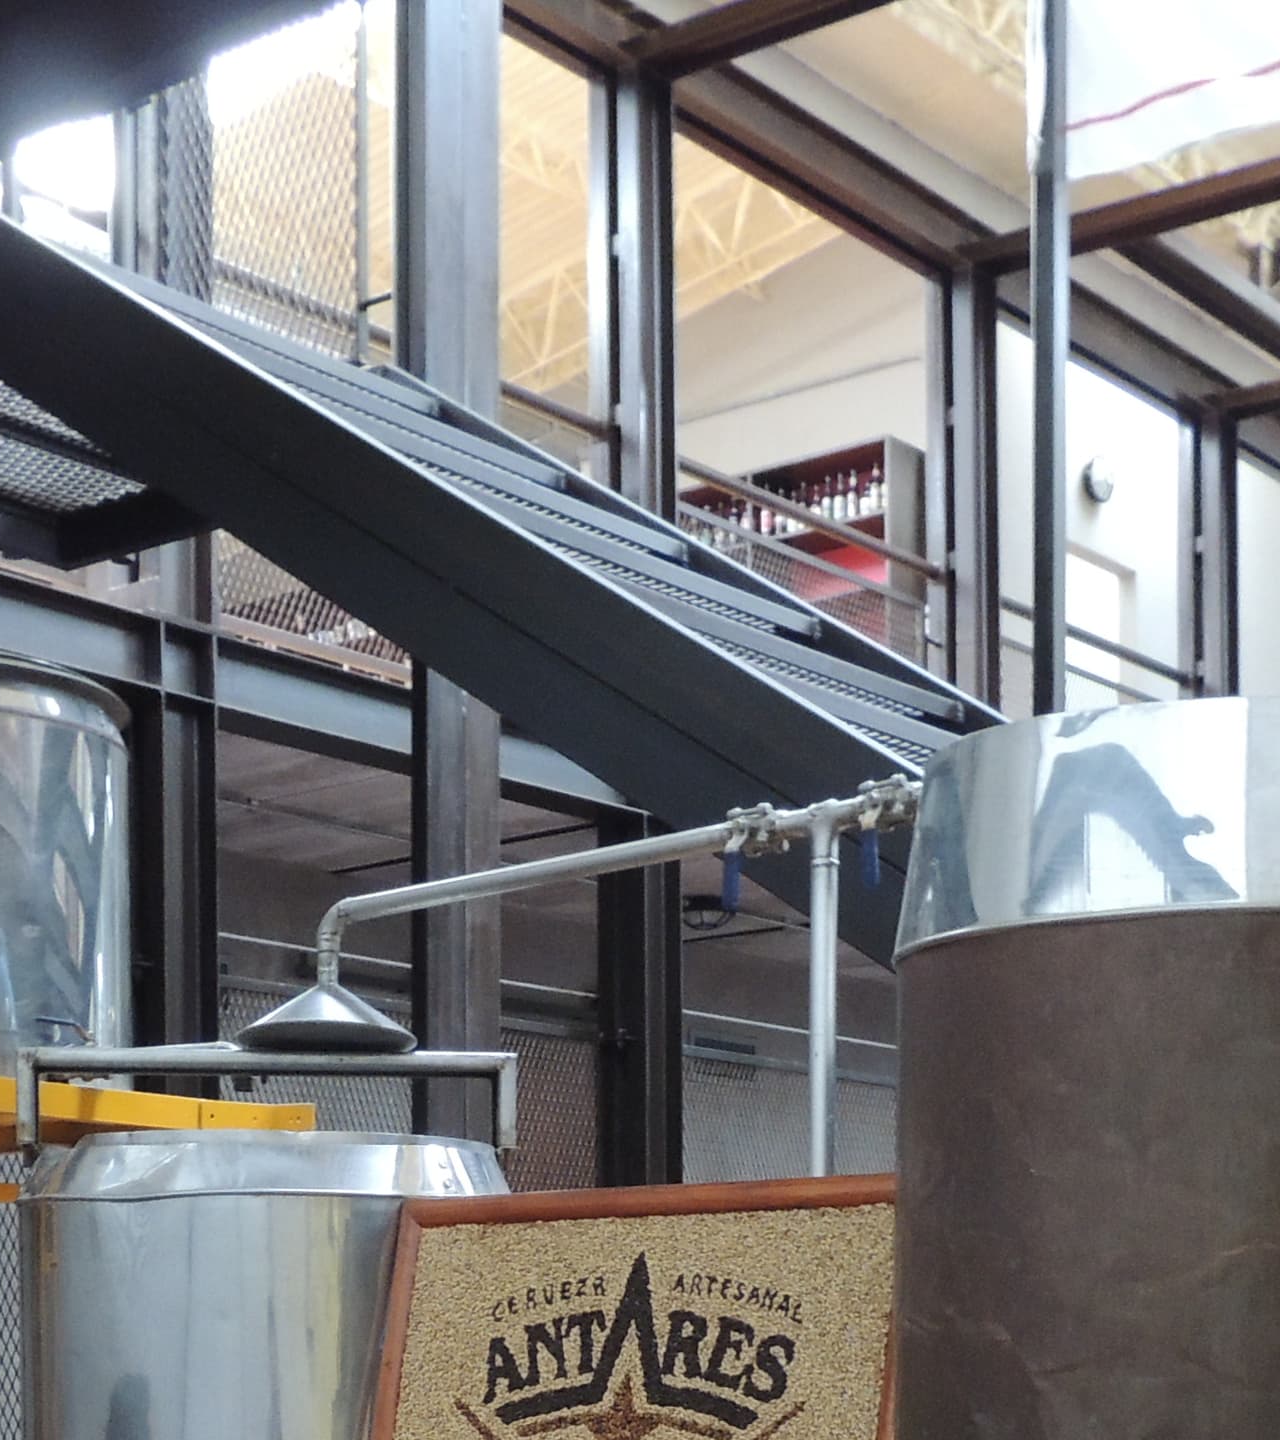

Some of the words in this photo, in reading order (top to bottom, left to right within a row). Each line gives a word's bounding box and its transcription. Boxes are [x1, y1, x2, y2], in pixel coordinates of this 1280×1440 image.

[482, 1250, 797, 1403] ANTARES
[490, 1275, 607, 1323] CERVEZA
[672, 1273, 804, 1325] ARTESANAL
